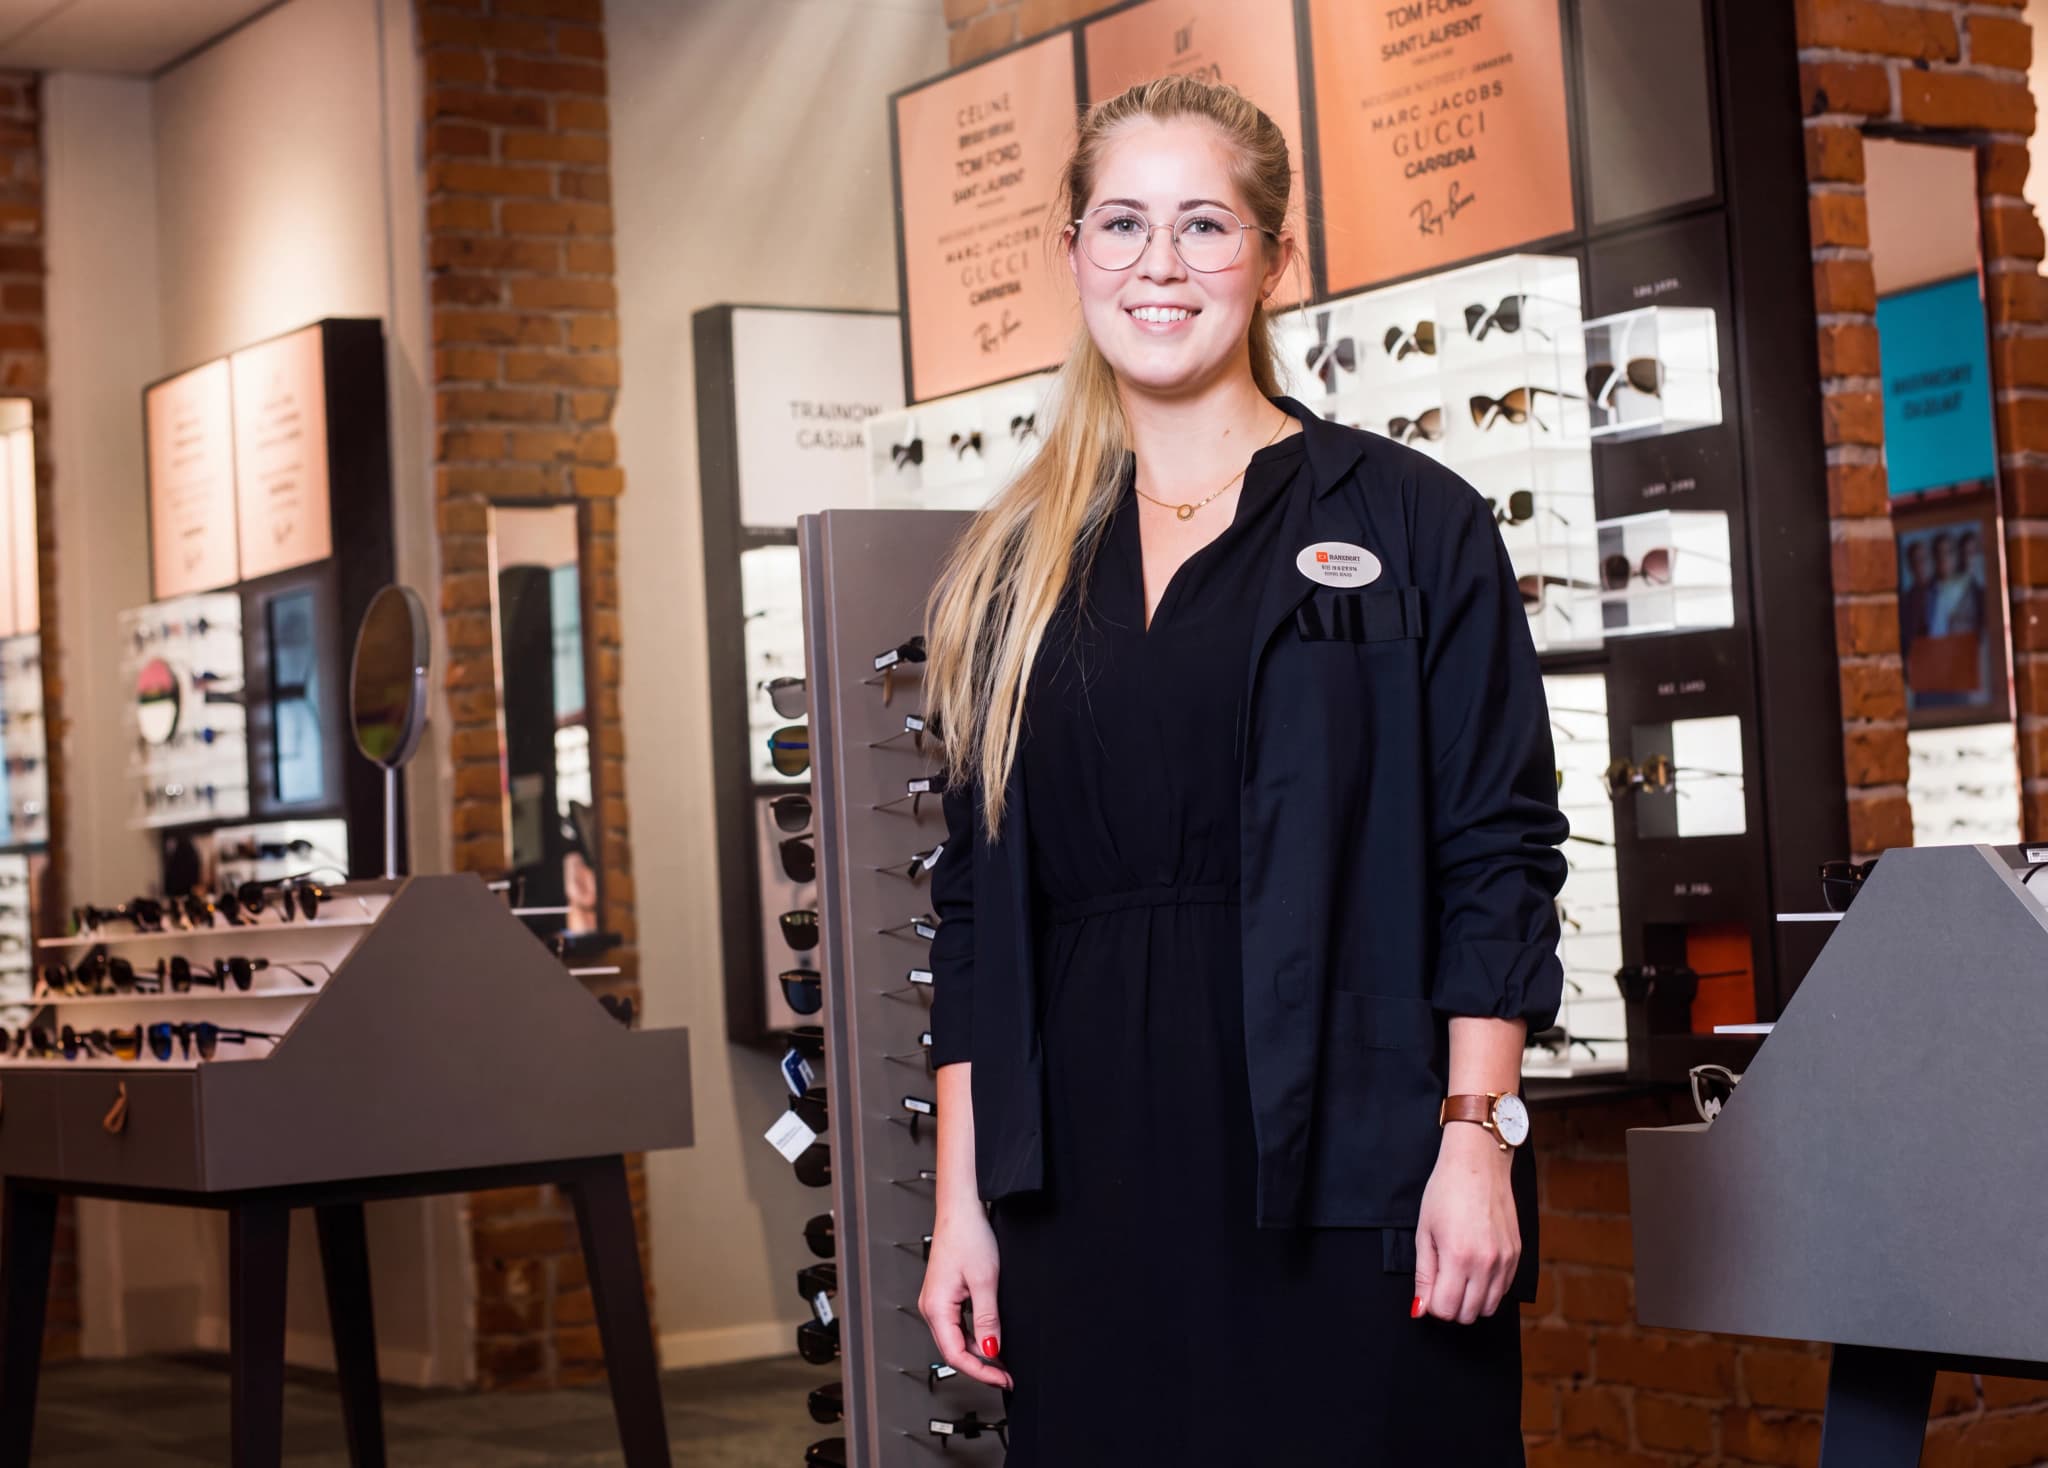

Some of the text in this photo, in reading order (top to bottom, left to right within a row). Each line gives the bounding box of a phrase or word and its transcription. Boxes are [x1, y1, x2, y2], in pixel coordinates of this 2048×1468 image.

[1385, 1, 1422, 31] TOM
[1381, 34, 1418, 62] SAINT
[1419, 13, 1483, 49] LAURENT
[1372, 103, 1421, 130] MARC
[1428, 79, 1503, 116] JACOBS
[1392, 108, 1486, 158] GUCCI
[1404, 144, 1477, 179] CARRERA
[960, 247, 1029, 289] GUCCI
[796, 427, 866, 450] CASUA
